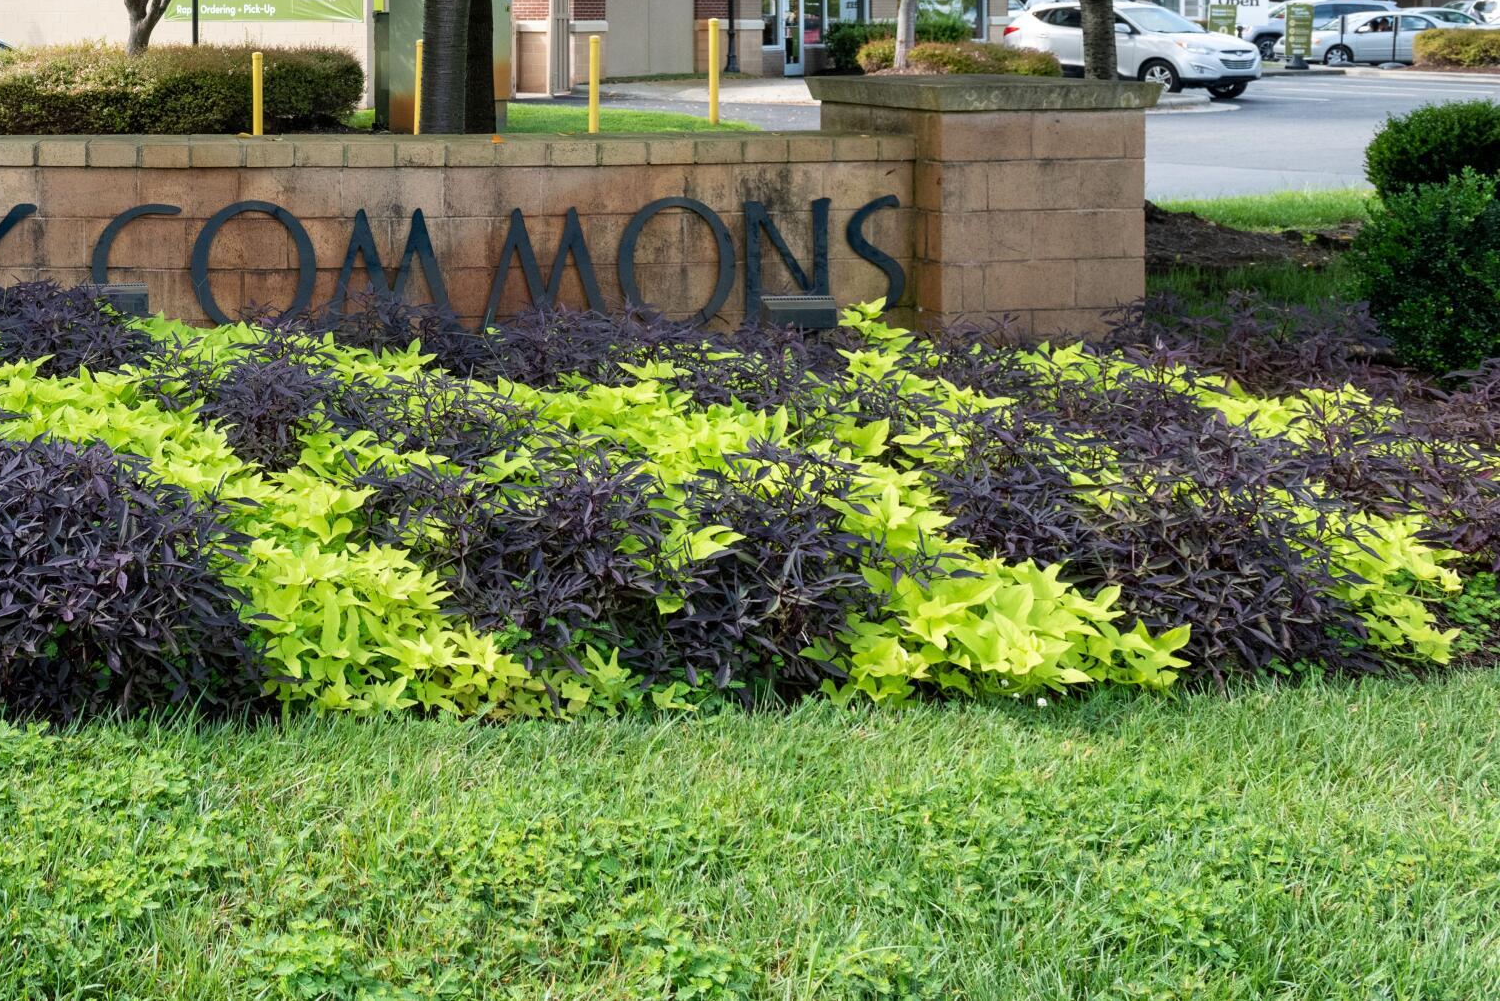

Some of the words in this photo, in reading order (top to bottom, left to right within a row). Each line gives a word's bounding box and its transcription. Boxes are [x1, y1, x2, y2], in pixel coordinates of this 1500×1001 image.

[176, 4, 192, 16] Rap
[200, 4, 236, 17] Ordering
[243, 4, 276, 16] Pick-Up
[91, 195, 906, 332] COMMONS
